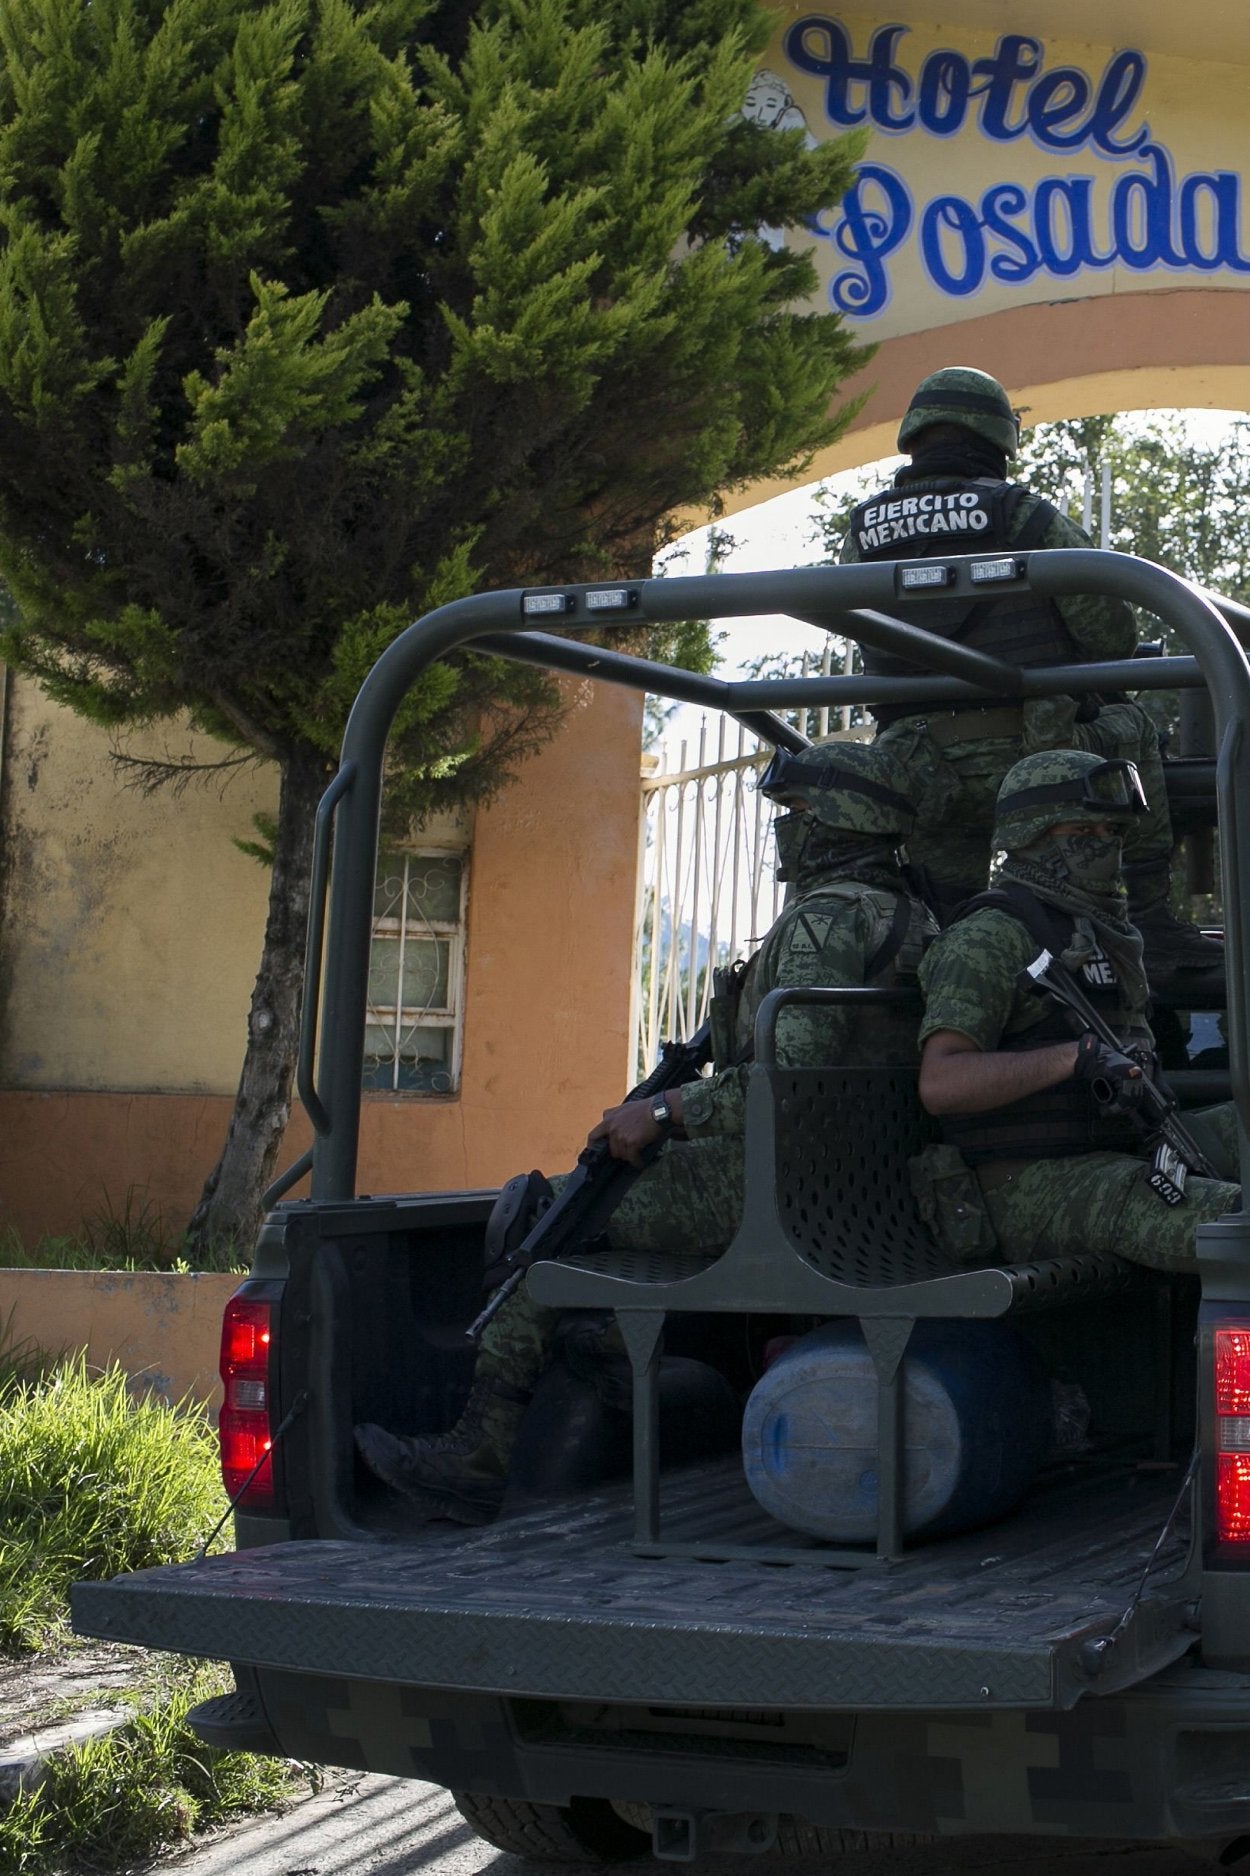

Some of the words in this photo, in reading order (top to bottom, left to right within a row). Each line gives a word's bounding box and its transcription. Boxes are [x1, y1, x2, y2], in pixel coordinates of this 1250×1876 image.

[784, 14, 1150, 160] Hotel
[858, 509, 988, 550] MEXICANO
[863, 492, 979, 528] EJERCITO
